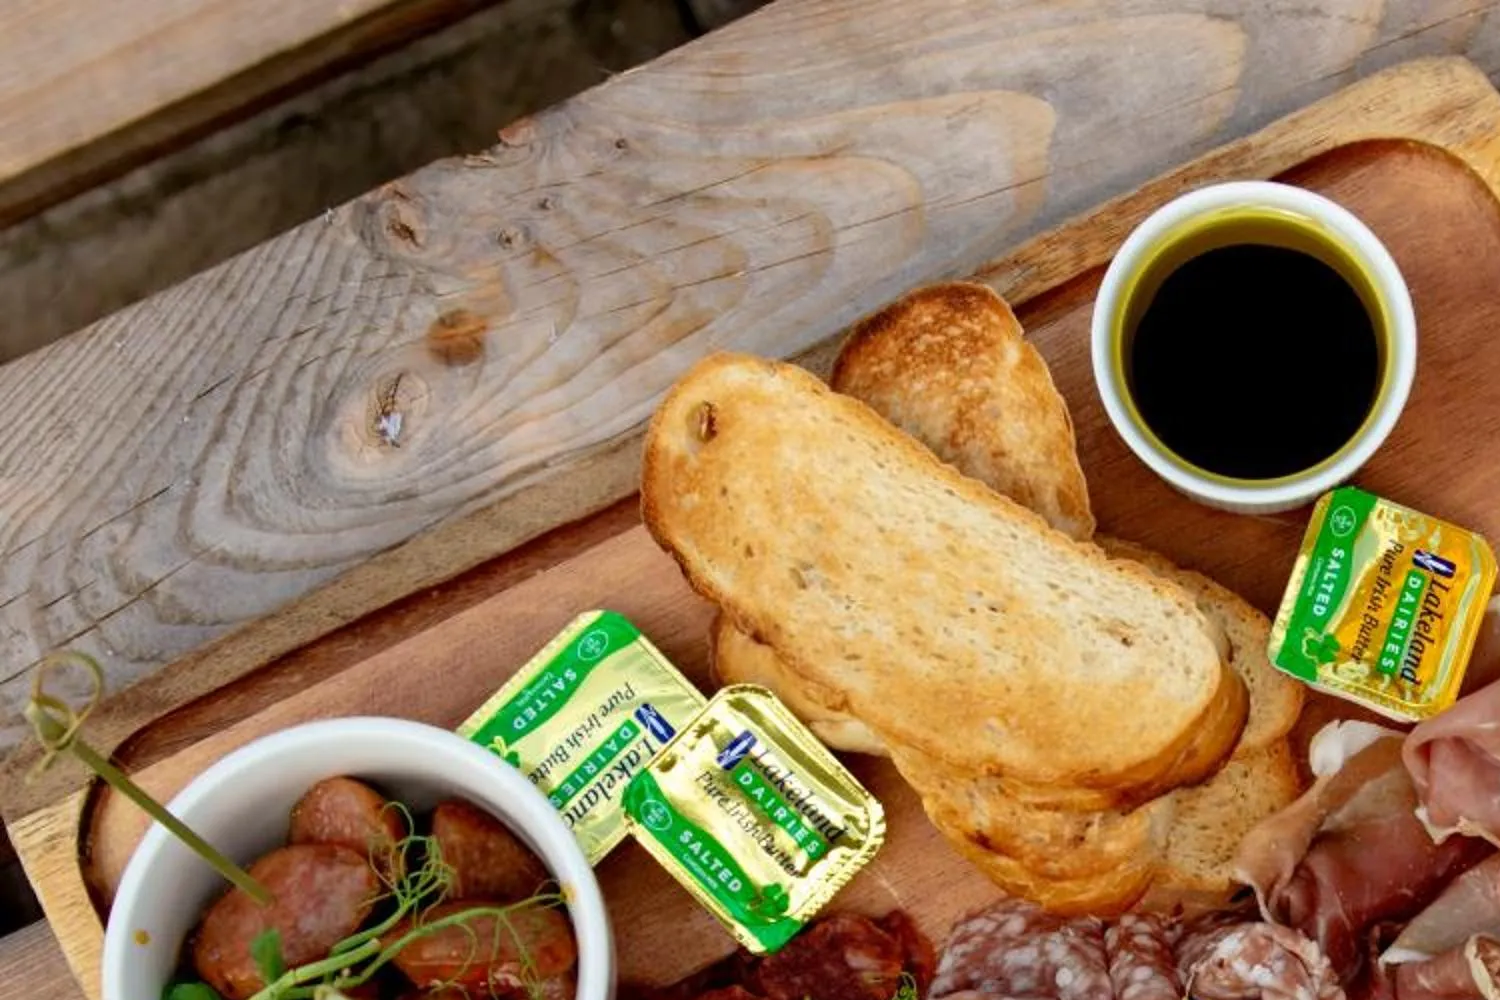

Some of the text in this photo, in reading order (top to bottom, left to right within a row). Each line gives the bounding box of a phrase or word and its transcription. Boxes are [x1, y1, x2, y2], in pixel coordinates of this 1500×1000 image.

[1311, 546, 1345, 618] SALTED
[1348, 539, 1404, 664] Pure Irish Butter
[1380, 575, 1420, 670] DAIRIES
[1398, 579, 1450, 685] Lakeland
[509, 666, 577, 732] SALTED
[564, 712, 603, 751] Irish
[596, 681, 637, 719] Pure
[525, 744, 570, 786] Butte
[750, 745, 849, 846] Lakeland
[738, 771, 821, 855] DAIRIES
[677, 828, 744, 894] SALTED
